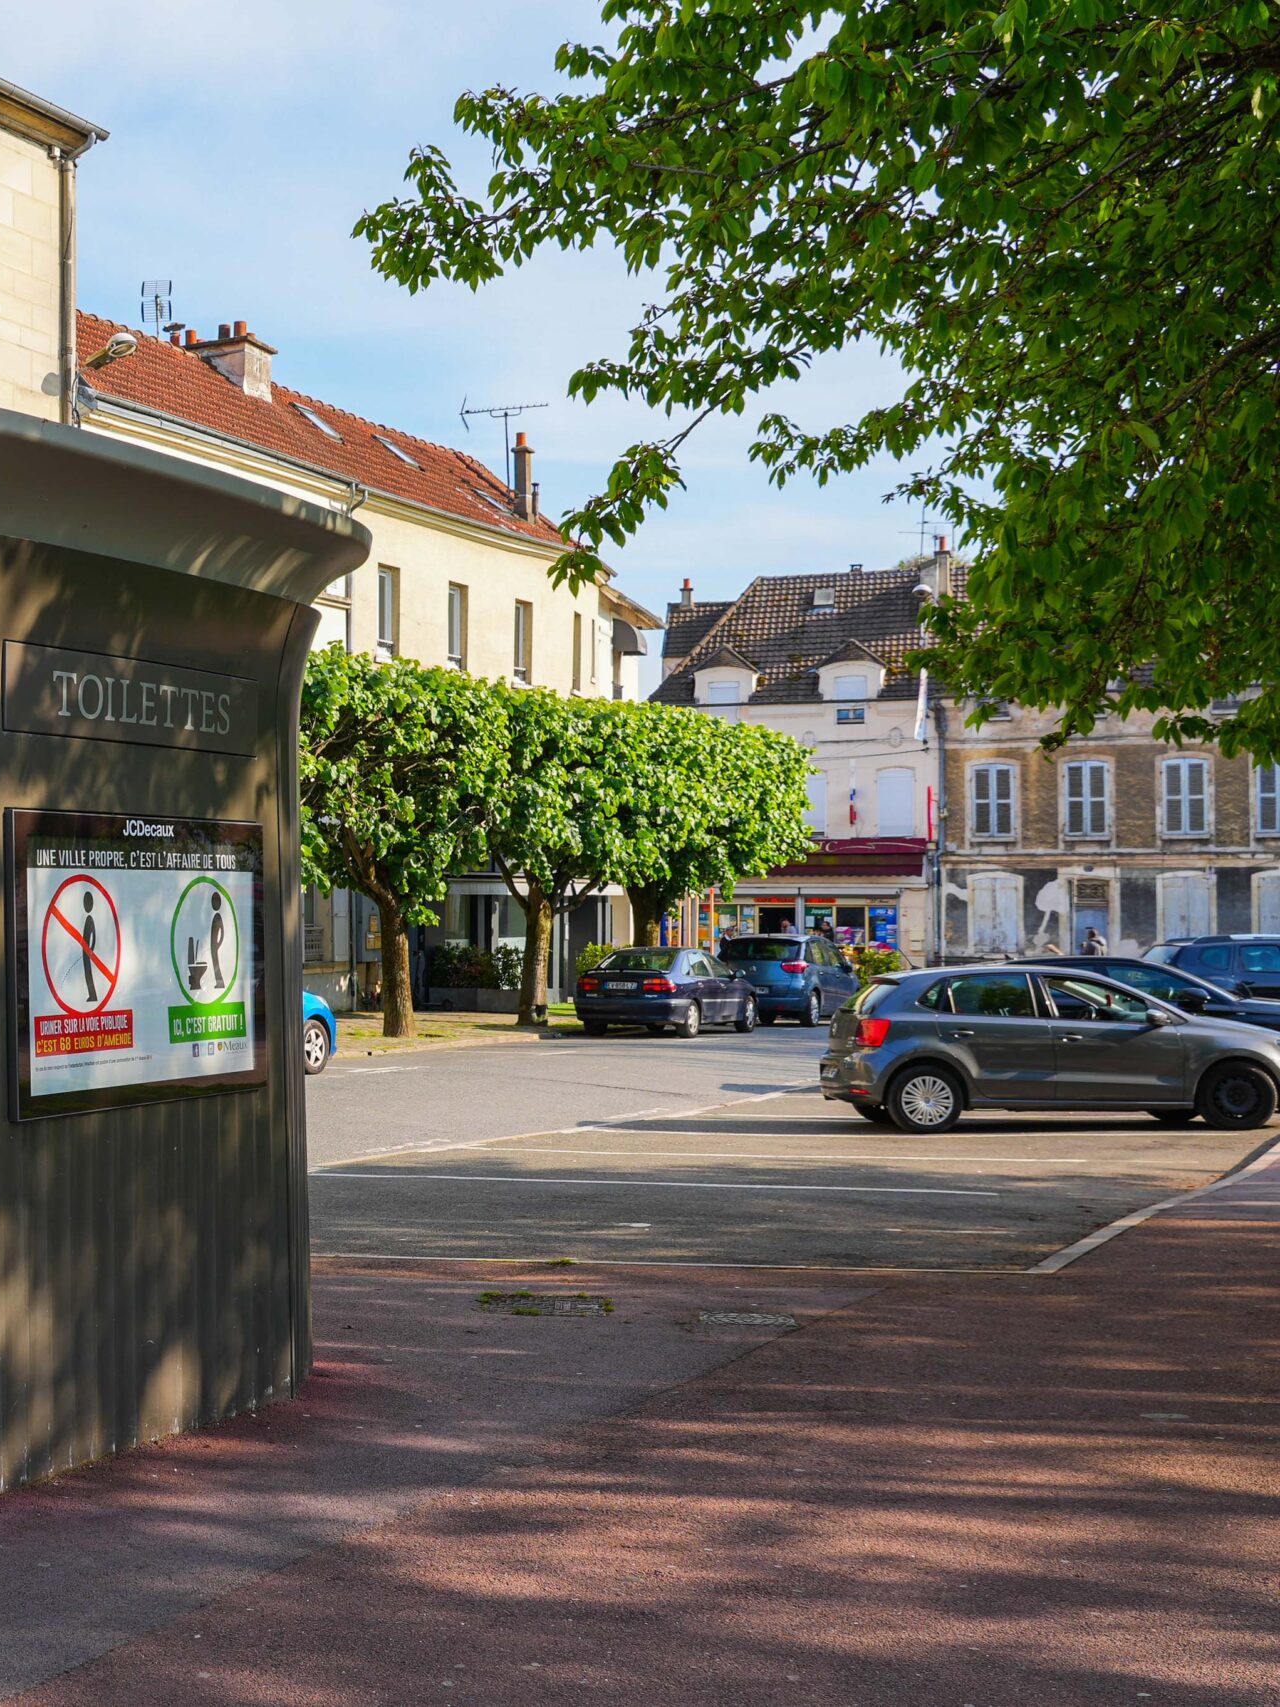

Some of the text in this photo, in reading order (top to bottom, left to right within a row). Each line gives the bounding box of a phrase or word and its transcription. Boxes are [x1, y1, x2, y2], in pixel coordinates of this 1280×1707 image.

[52, 670, 231, 736] TOILETTES
[123, 819, 175, 838] JCDecaux
[36, 849, 236, 870] UNE VILLE PROPRE, C'EST L'AFFAIRE DE TOUS
[40, 1014, 128, 1036] URINER SUR LA VOIE PUBLIQUE
[173, 1018, 184, 1037] ICI,
[186, 1016, 206, 1035] C'EST
[208, 1014, 238, 1033] GRATUIT
[36, 1032, 132, 1054] C'EST 68 EUROS D'AMENDE
[224, 1040, 248, 1052] Meaux
